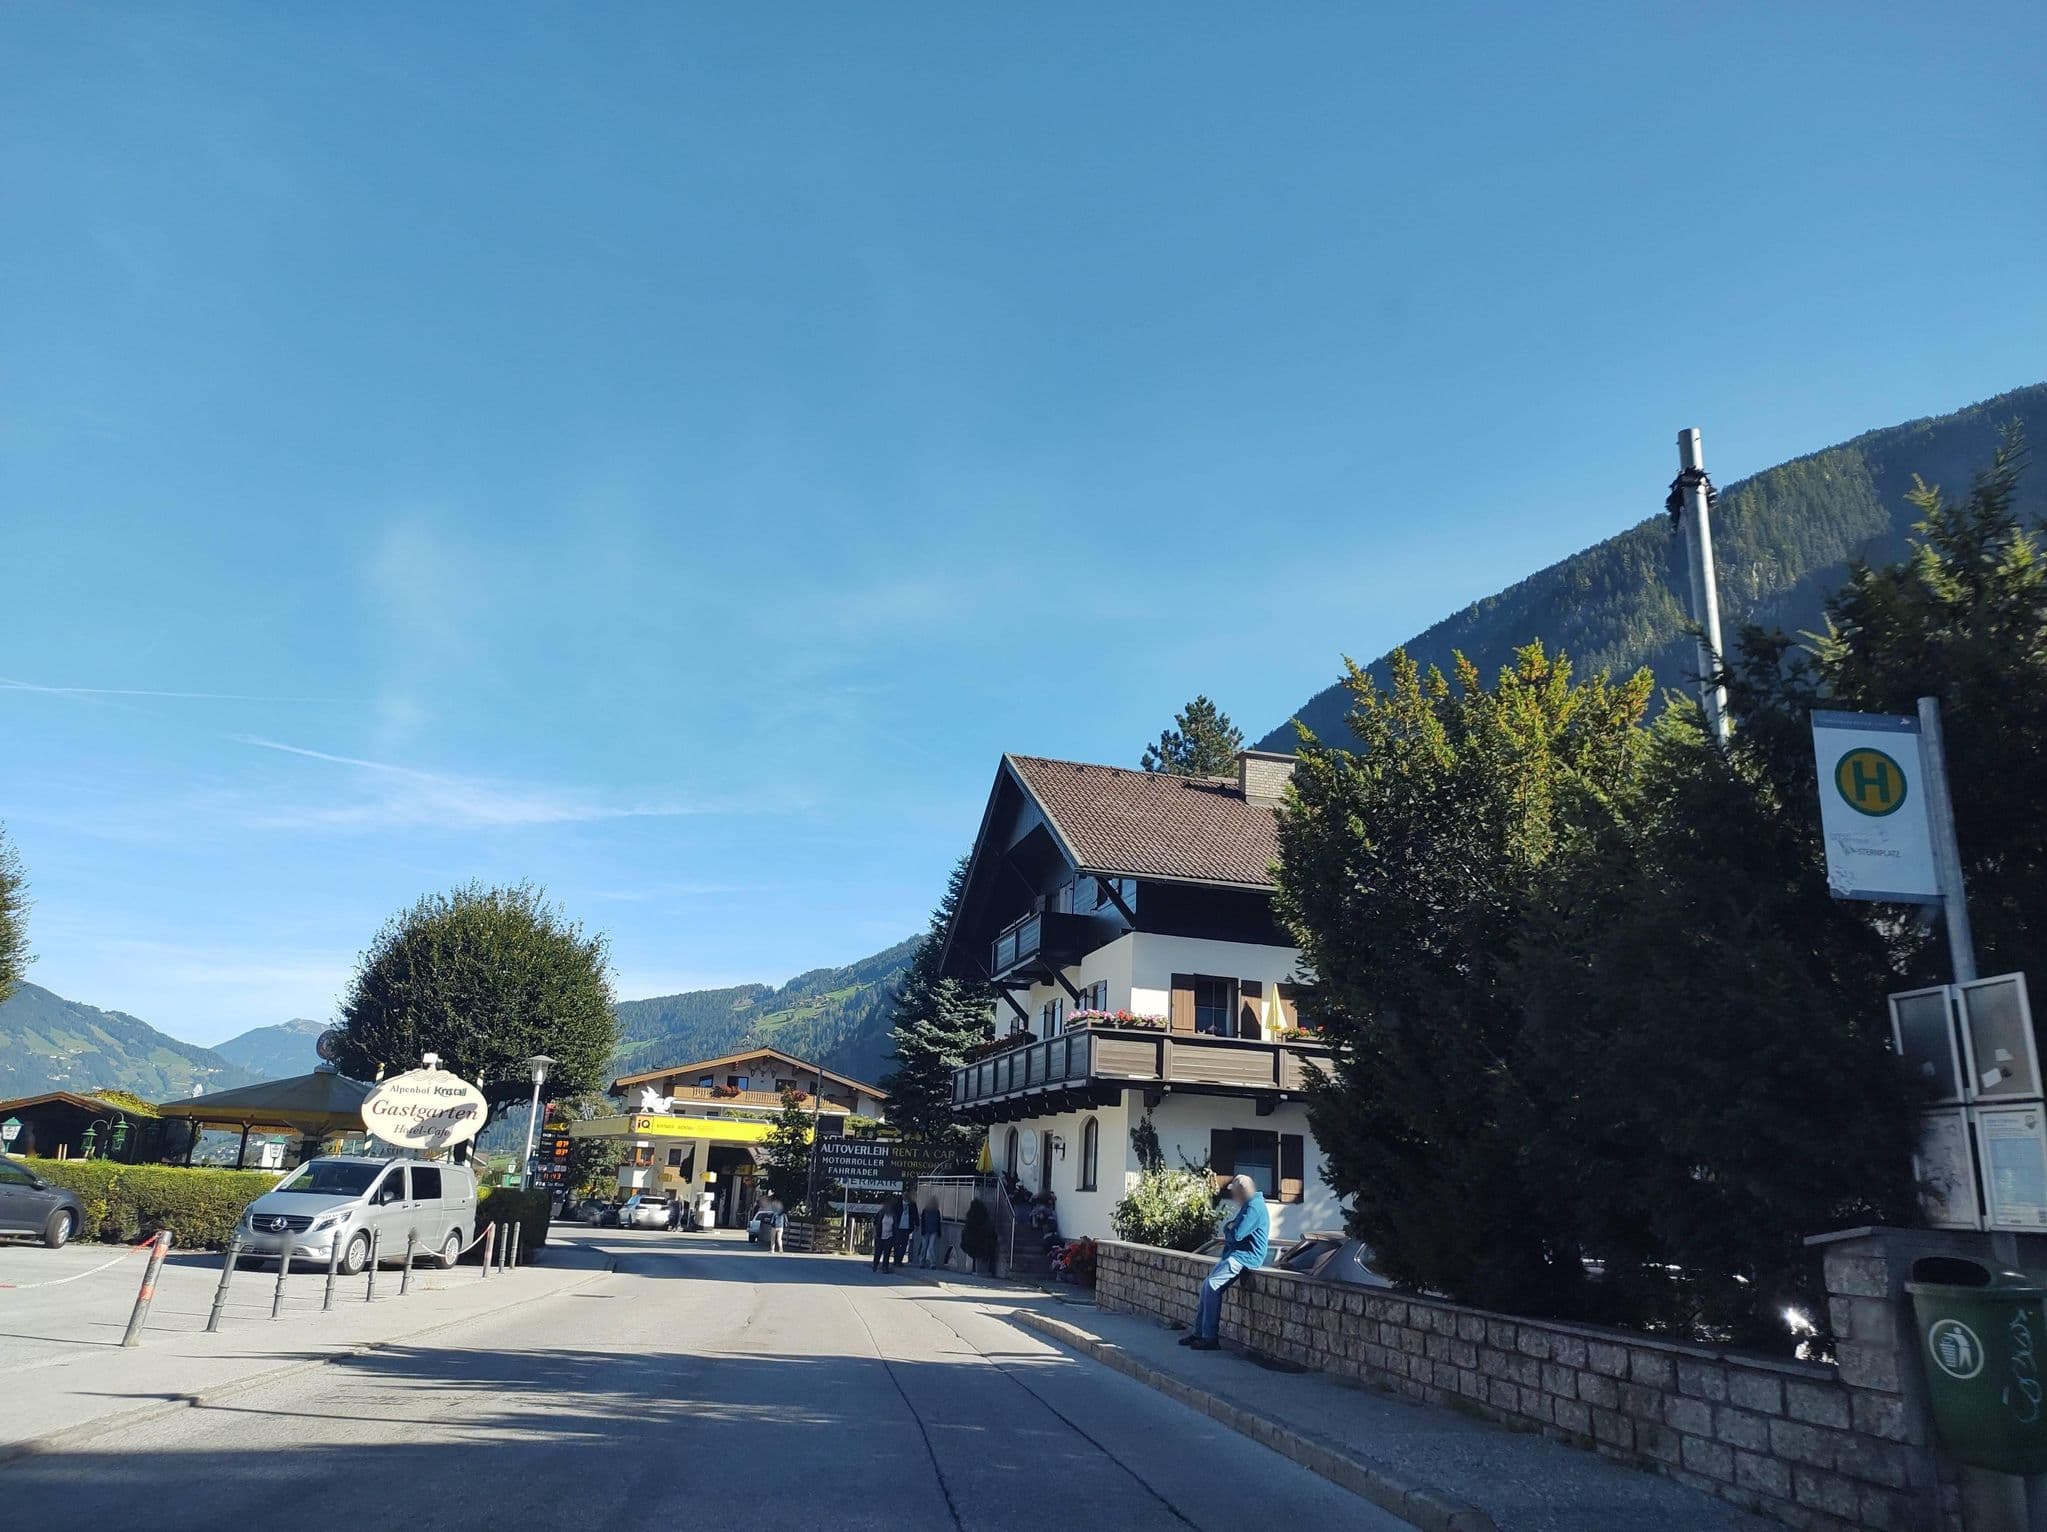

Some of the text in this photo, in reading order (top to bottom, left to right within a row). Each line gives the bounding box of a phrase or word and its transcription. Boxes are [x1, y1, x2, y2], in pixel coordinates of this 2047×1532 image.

[1852, 760, 1890, 803] H
[389, 1085, 468, 1097] Alpenhof Kristall
[372, 1099, 478, 1122] Gastgarten
[637, 1119, 651, 1129] iQ
[820, 1143, 889, 1157] AUTOVERLEIH
[891, 1147, 919, 1157] RENT
[922, 1149, 930, 1158] A
[822, 1156, 884, 1167] MOTORROLLER
